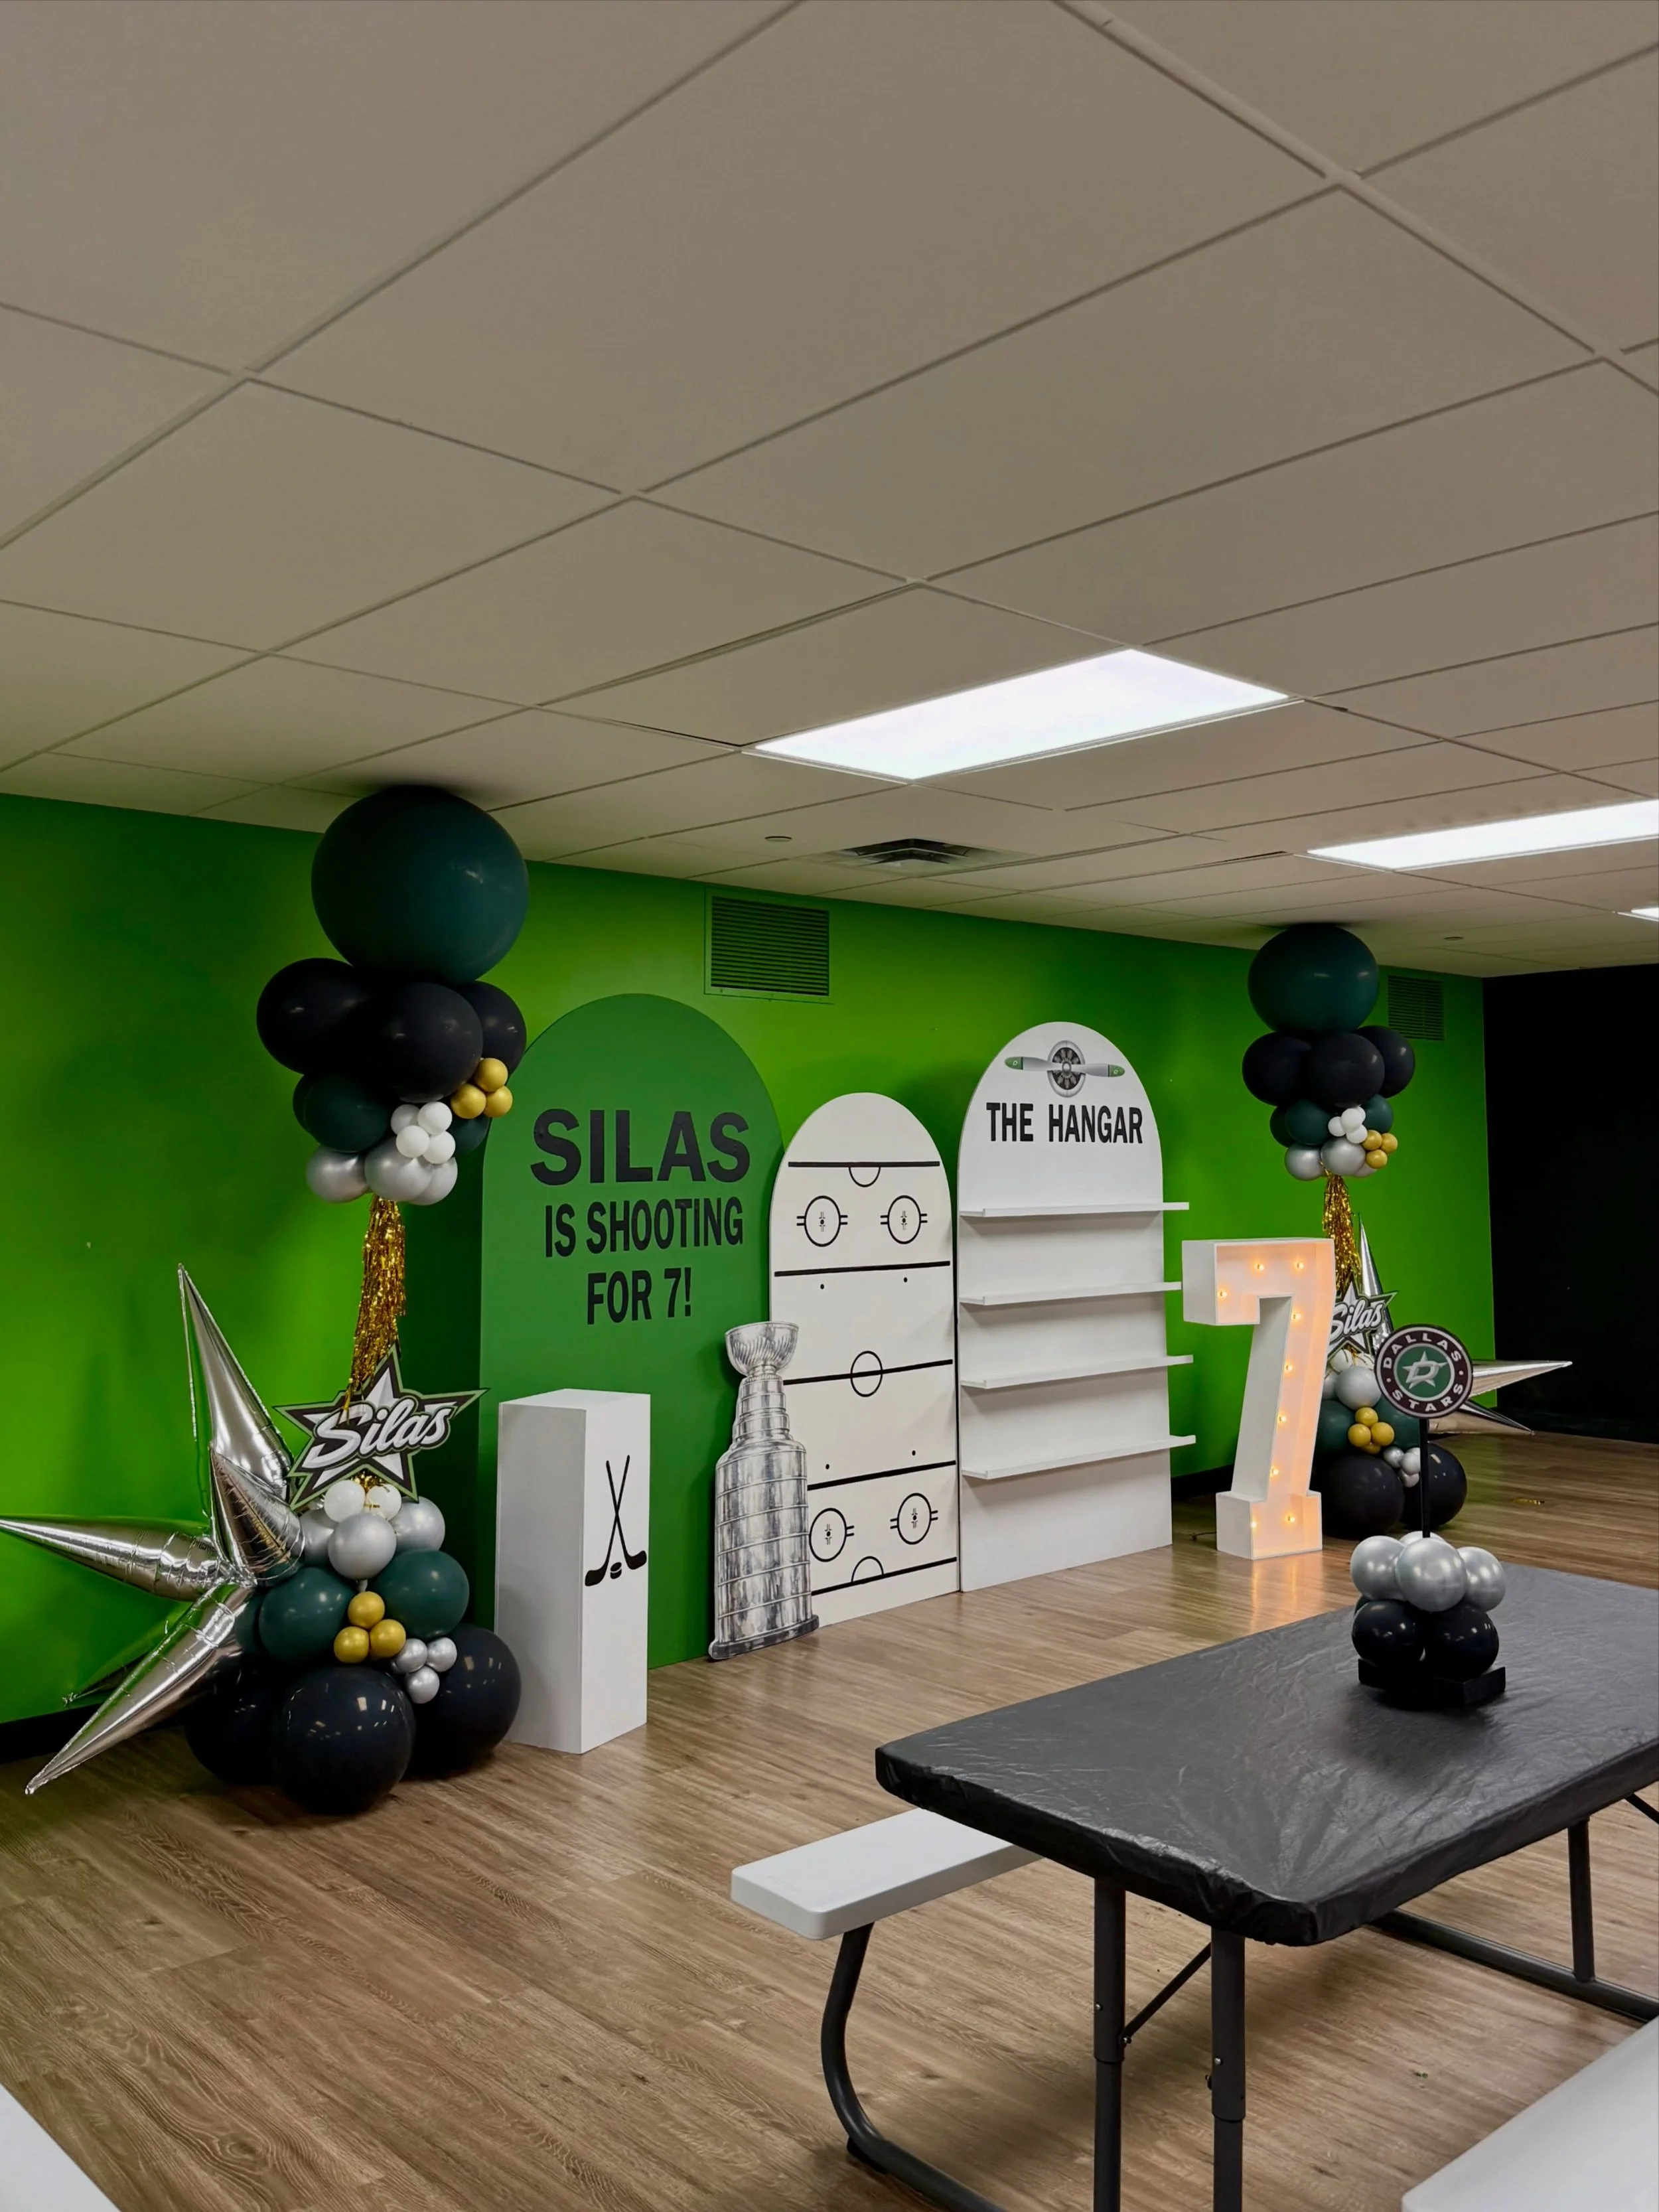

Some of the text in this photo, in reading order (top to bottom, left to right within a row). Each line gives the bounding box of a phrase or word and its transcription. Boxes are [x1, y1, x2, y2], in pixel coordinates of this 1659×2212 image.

[531, 1108, 750, 1186] SILAS
[986, 1102, 1143, 1143] THE HANGAR
[545, 1197, 743, 1258] IS SHOOTING
[587, 1267, 692, 1325] FOR 7!
[1330, 1299, 1382, 1340] Silas
[1383, 1333, 1462, 1369] DALLAS
[1182, 1237, 1336, 1560] 7
[1392, 1383, 1463, 1412] STARS
[301, 1396, 453, 1469] Silas
